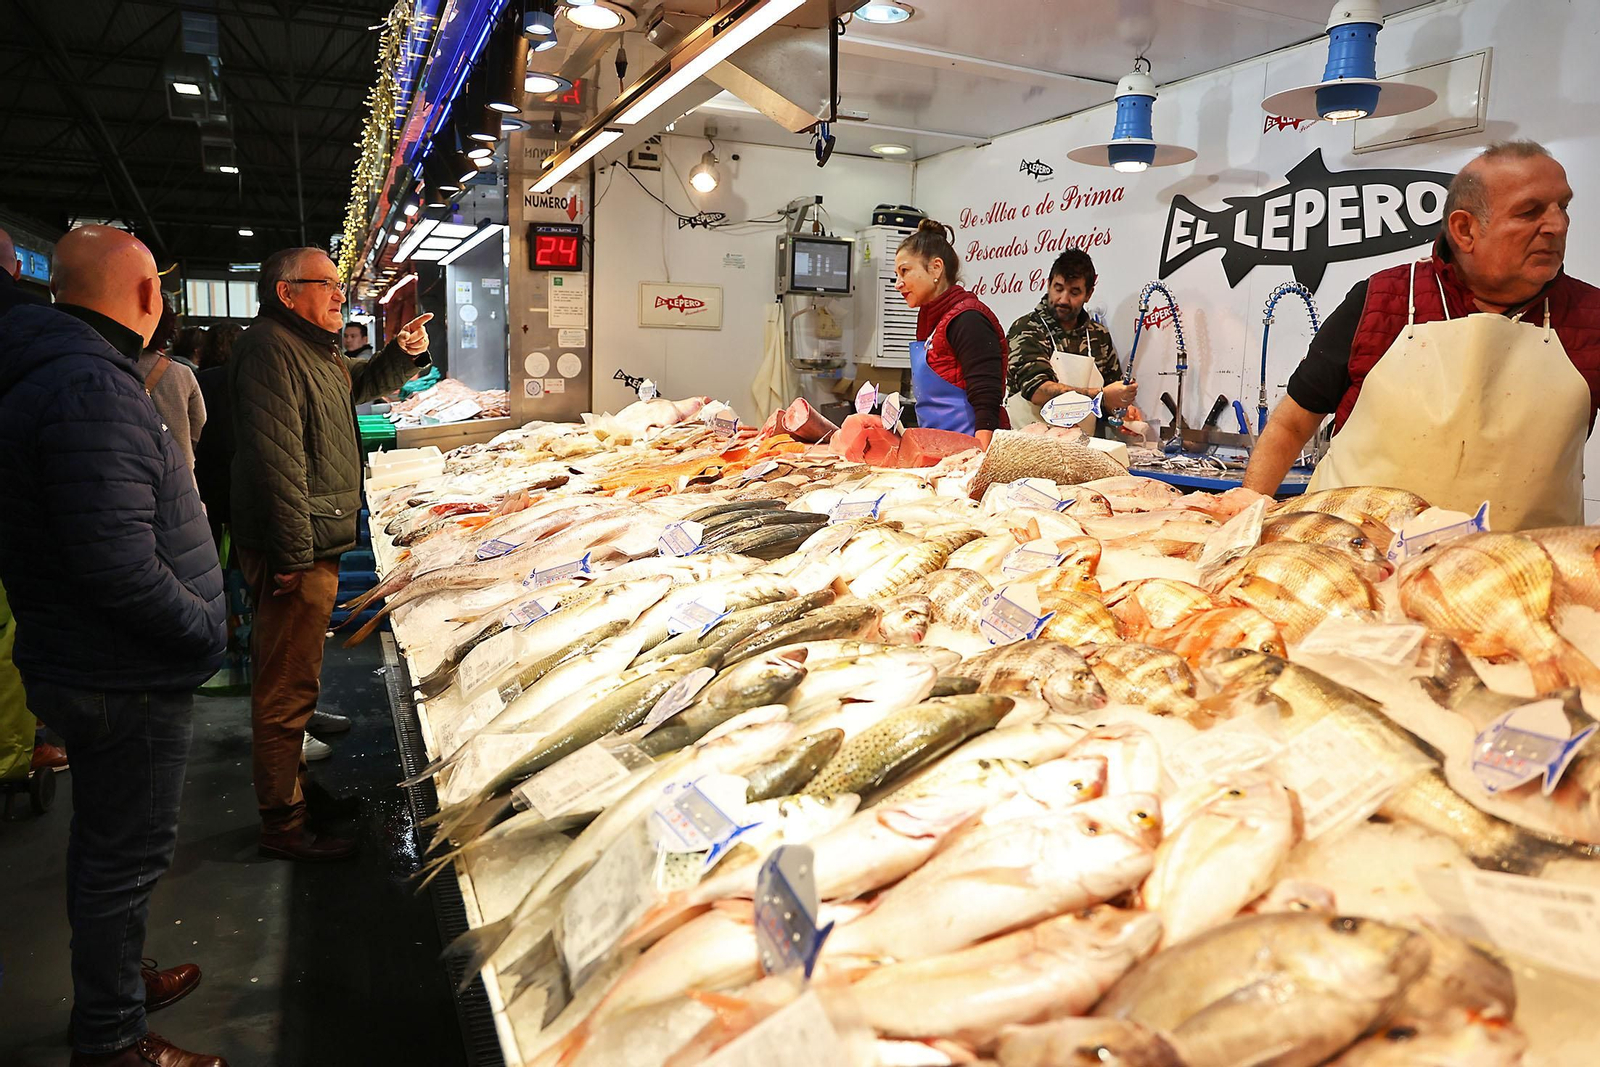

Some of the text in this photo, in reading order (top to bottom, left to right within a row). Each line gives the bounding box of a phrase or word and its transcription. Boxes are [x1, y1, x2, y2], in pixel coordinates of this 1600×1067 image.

[1029, 162, 1050, 174] LEPERO
[525, 195, 568, 209] NUMERO
[959, 185, 1125, 230] De Alba o de Prima
[1166, 181, 1449, 263] EL LEPERO
[536, 237, 577, 265] 24
[965, 227, 1112, 262] Pescados Salvajes
[972, 276, 987, 296] de
[991, 272, 1023, 294] Isla
[669, 298, 701, 308] LEPERO
[1146, 308, 1174, 324] LEPER
